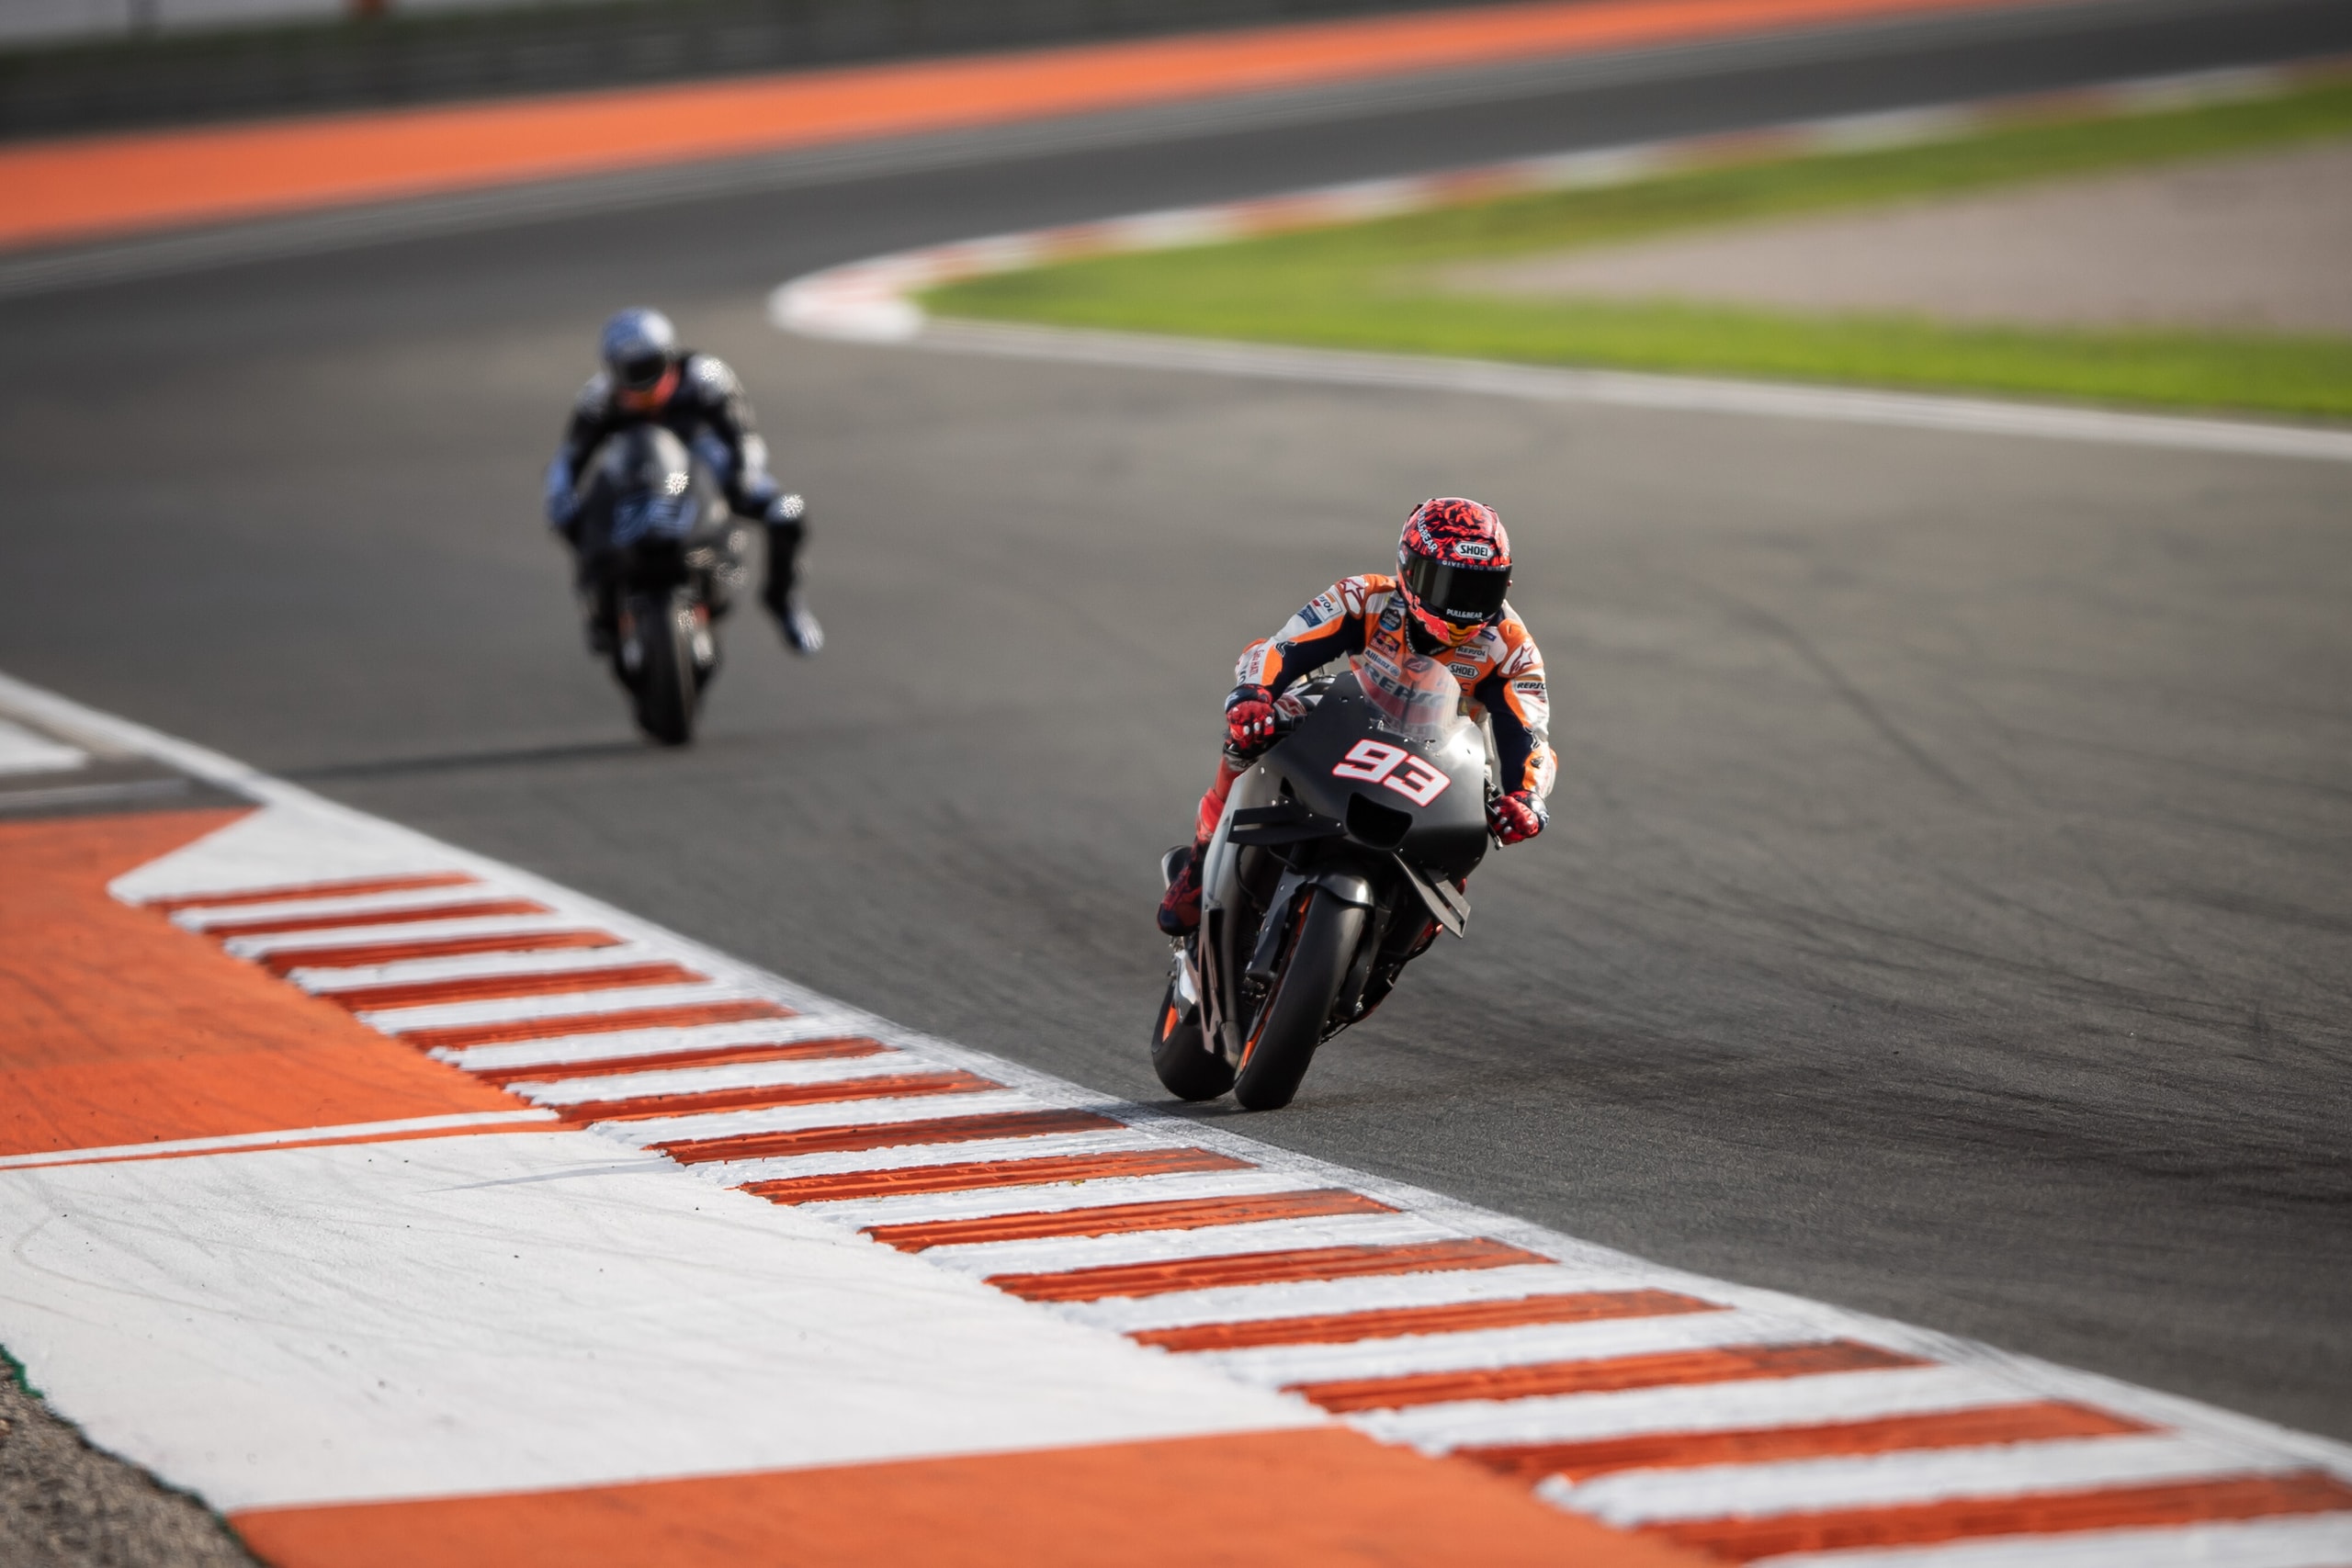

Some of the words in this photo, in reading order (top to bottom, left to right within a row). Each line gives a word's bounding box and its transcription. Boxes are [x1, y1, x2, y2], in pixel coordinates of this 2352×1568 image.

[1460, 545, 1488, 558] SHOEI
[1446, 608, 1483, 620] PULL&BEAR
[1457, 646, 1487, 658] REPSOL
[1365, 649, 1390, 669] Allianz
[1450, 664, 1476, 677] SHOEI
[1332, 738, 1451, 807] 93
